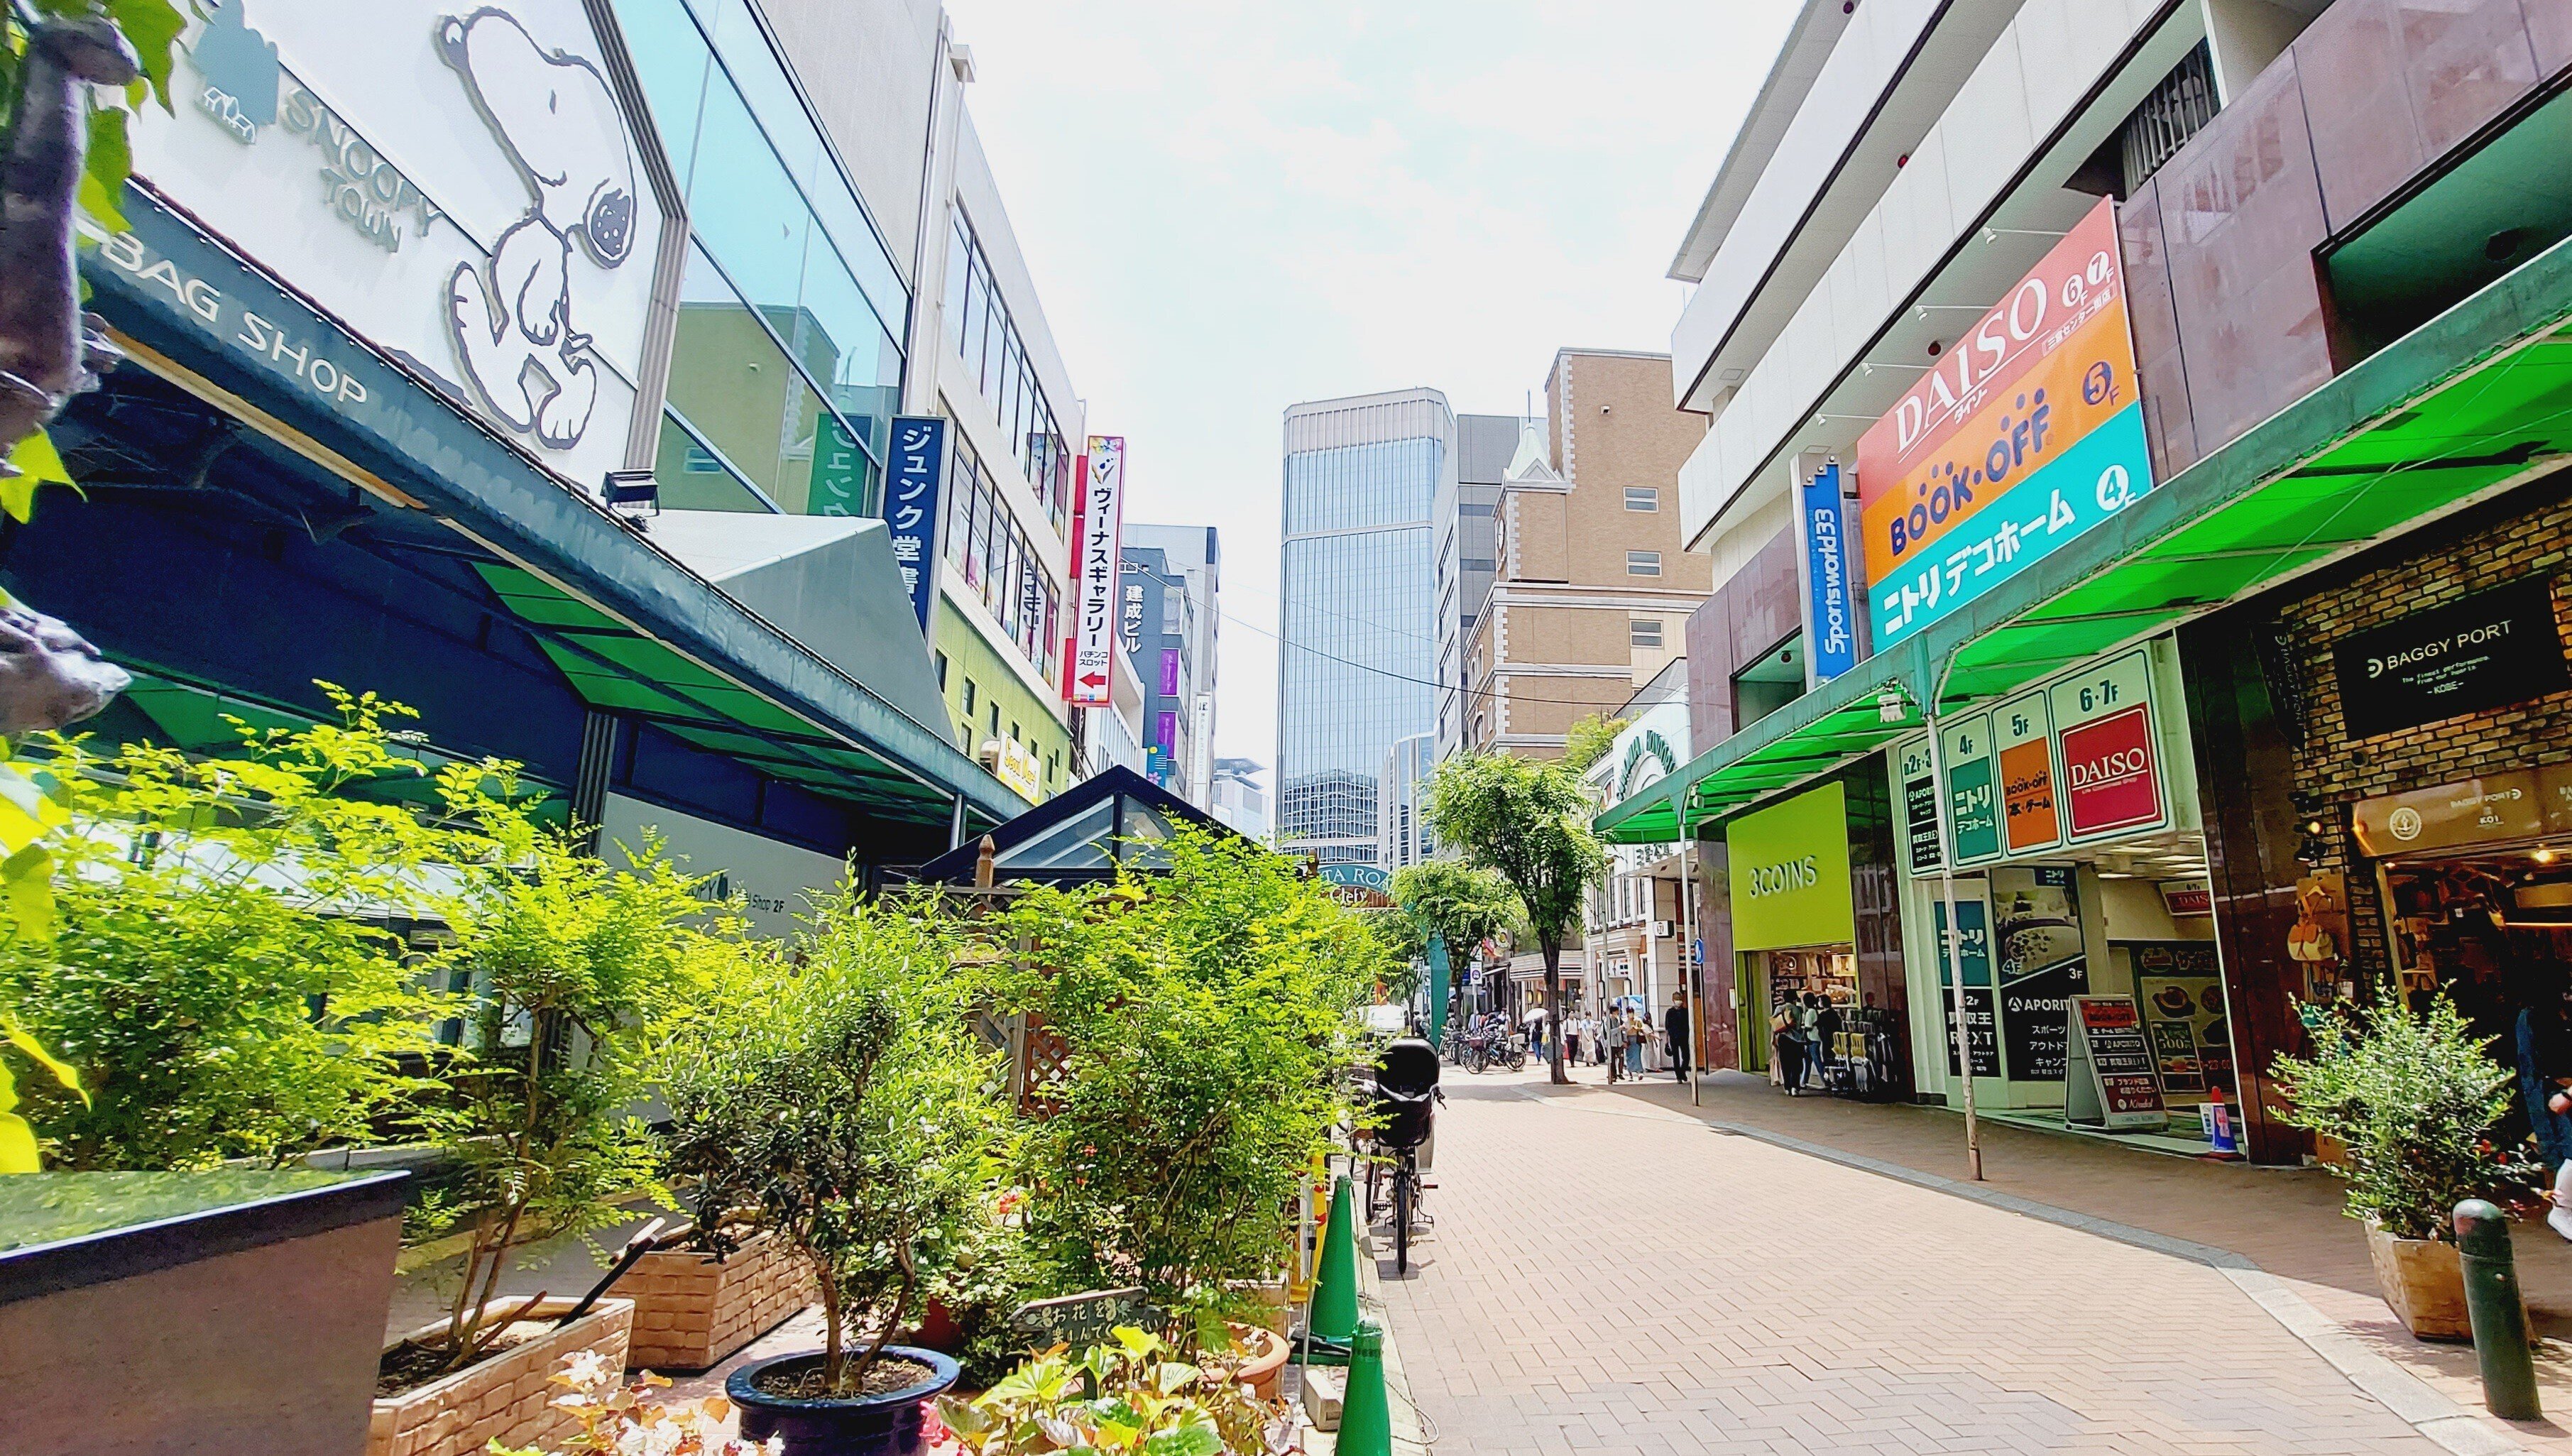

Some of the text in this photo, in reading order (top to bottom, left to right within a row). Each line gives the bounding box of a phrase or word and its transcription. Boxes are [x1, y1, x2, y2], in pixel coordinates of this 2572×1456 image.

[286, 88, 455, 238] SNOOPY
[319, 168, 402, 253] TOWN
[100, 231, 368, 403] BAG SHOP
[1895, 278, 2047, 454] DAISO
[1954, 388, 1988, 425] ダイソー
[1087, 487, 1112, 647] ヴィーナスギャラリー
[1815, 508, 1850, 655] Sportsworld33
[1123, 584, 1145, 654] 建成ビル
[2387, 619, 2512, 670] BAGGY PORT
[2011, 714, 2029, 737] 5F
[1959, 734, 1974, 755] 4F
[2070, 748, 2145, 787] DAISO
[1915, 786, 1935, 799] APORIT
[1954, 784, 1991, 816] ニトリ
[1957, 814, 1994, 835] デコホーム
[1354, 867, 1390, 890] ROA
[1749, 855, 1817, 899] 3COINS
[773, 899, 785, 914] 2F
[2179, 892, 2209, 904] DAIS
[1942, 948, 1986, 957] デホーム
[2002, 958, 2023, 975] 4F
[2068, 968, 2083, 979] 3F
[2025, 999, 2069, 1011] APORIT
[2032, 1025, 2067, 1034] スポーツ
[1052, 1317, 1164, 1345] 楽しんでくさい
